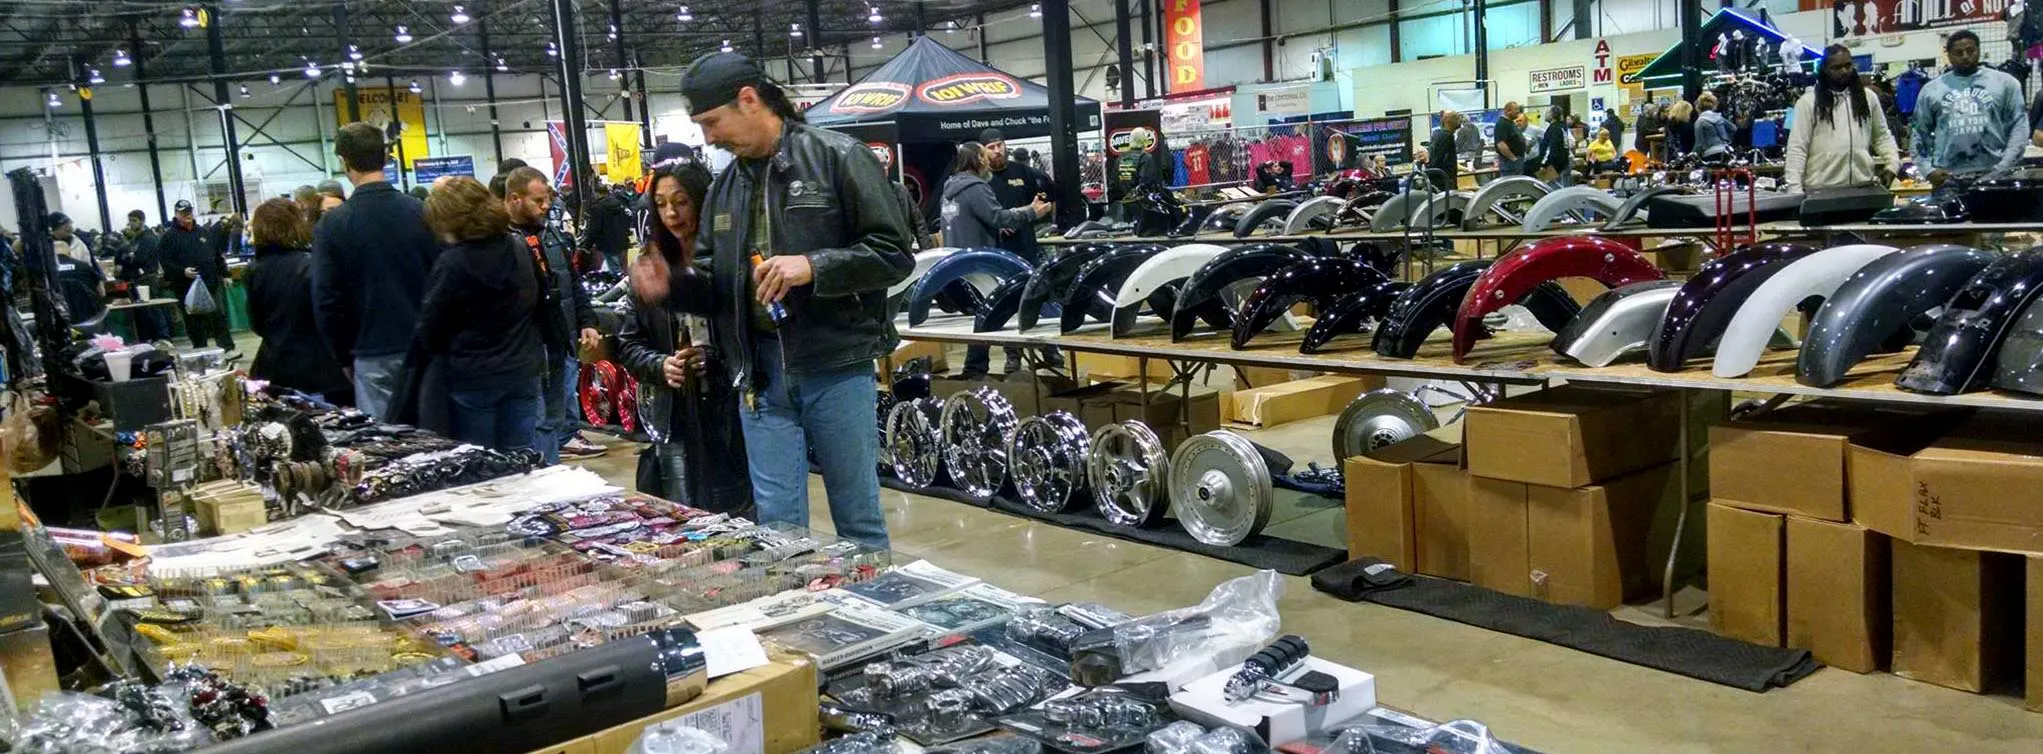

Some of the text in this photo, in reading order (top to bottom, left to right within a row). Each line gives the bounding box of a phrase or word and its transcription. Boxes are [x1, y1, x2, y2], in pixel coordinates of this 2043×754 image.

[1174, 0, 1197, 85] FOOD
[1594, 39, 1612, 82] ATM
[1532, 68, 1582, 83] RESTROOMS
[940, 121, 961, 130] Home
[963, 120, 971, 128] of
[972, 119, 989, 128] Dave
[990, 118, 1004, 126] and
[1004, 116, 1026, 126] Chuck
